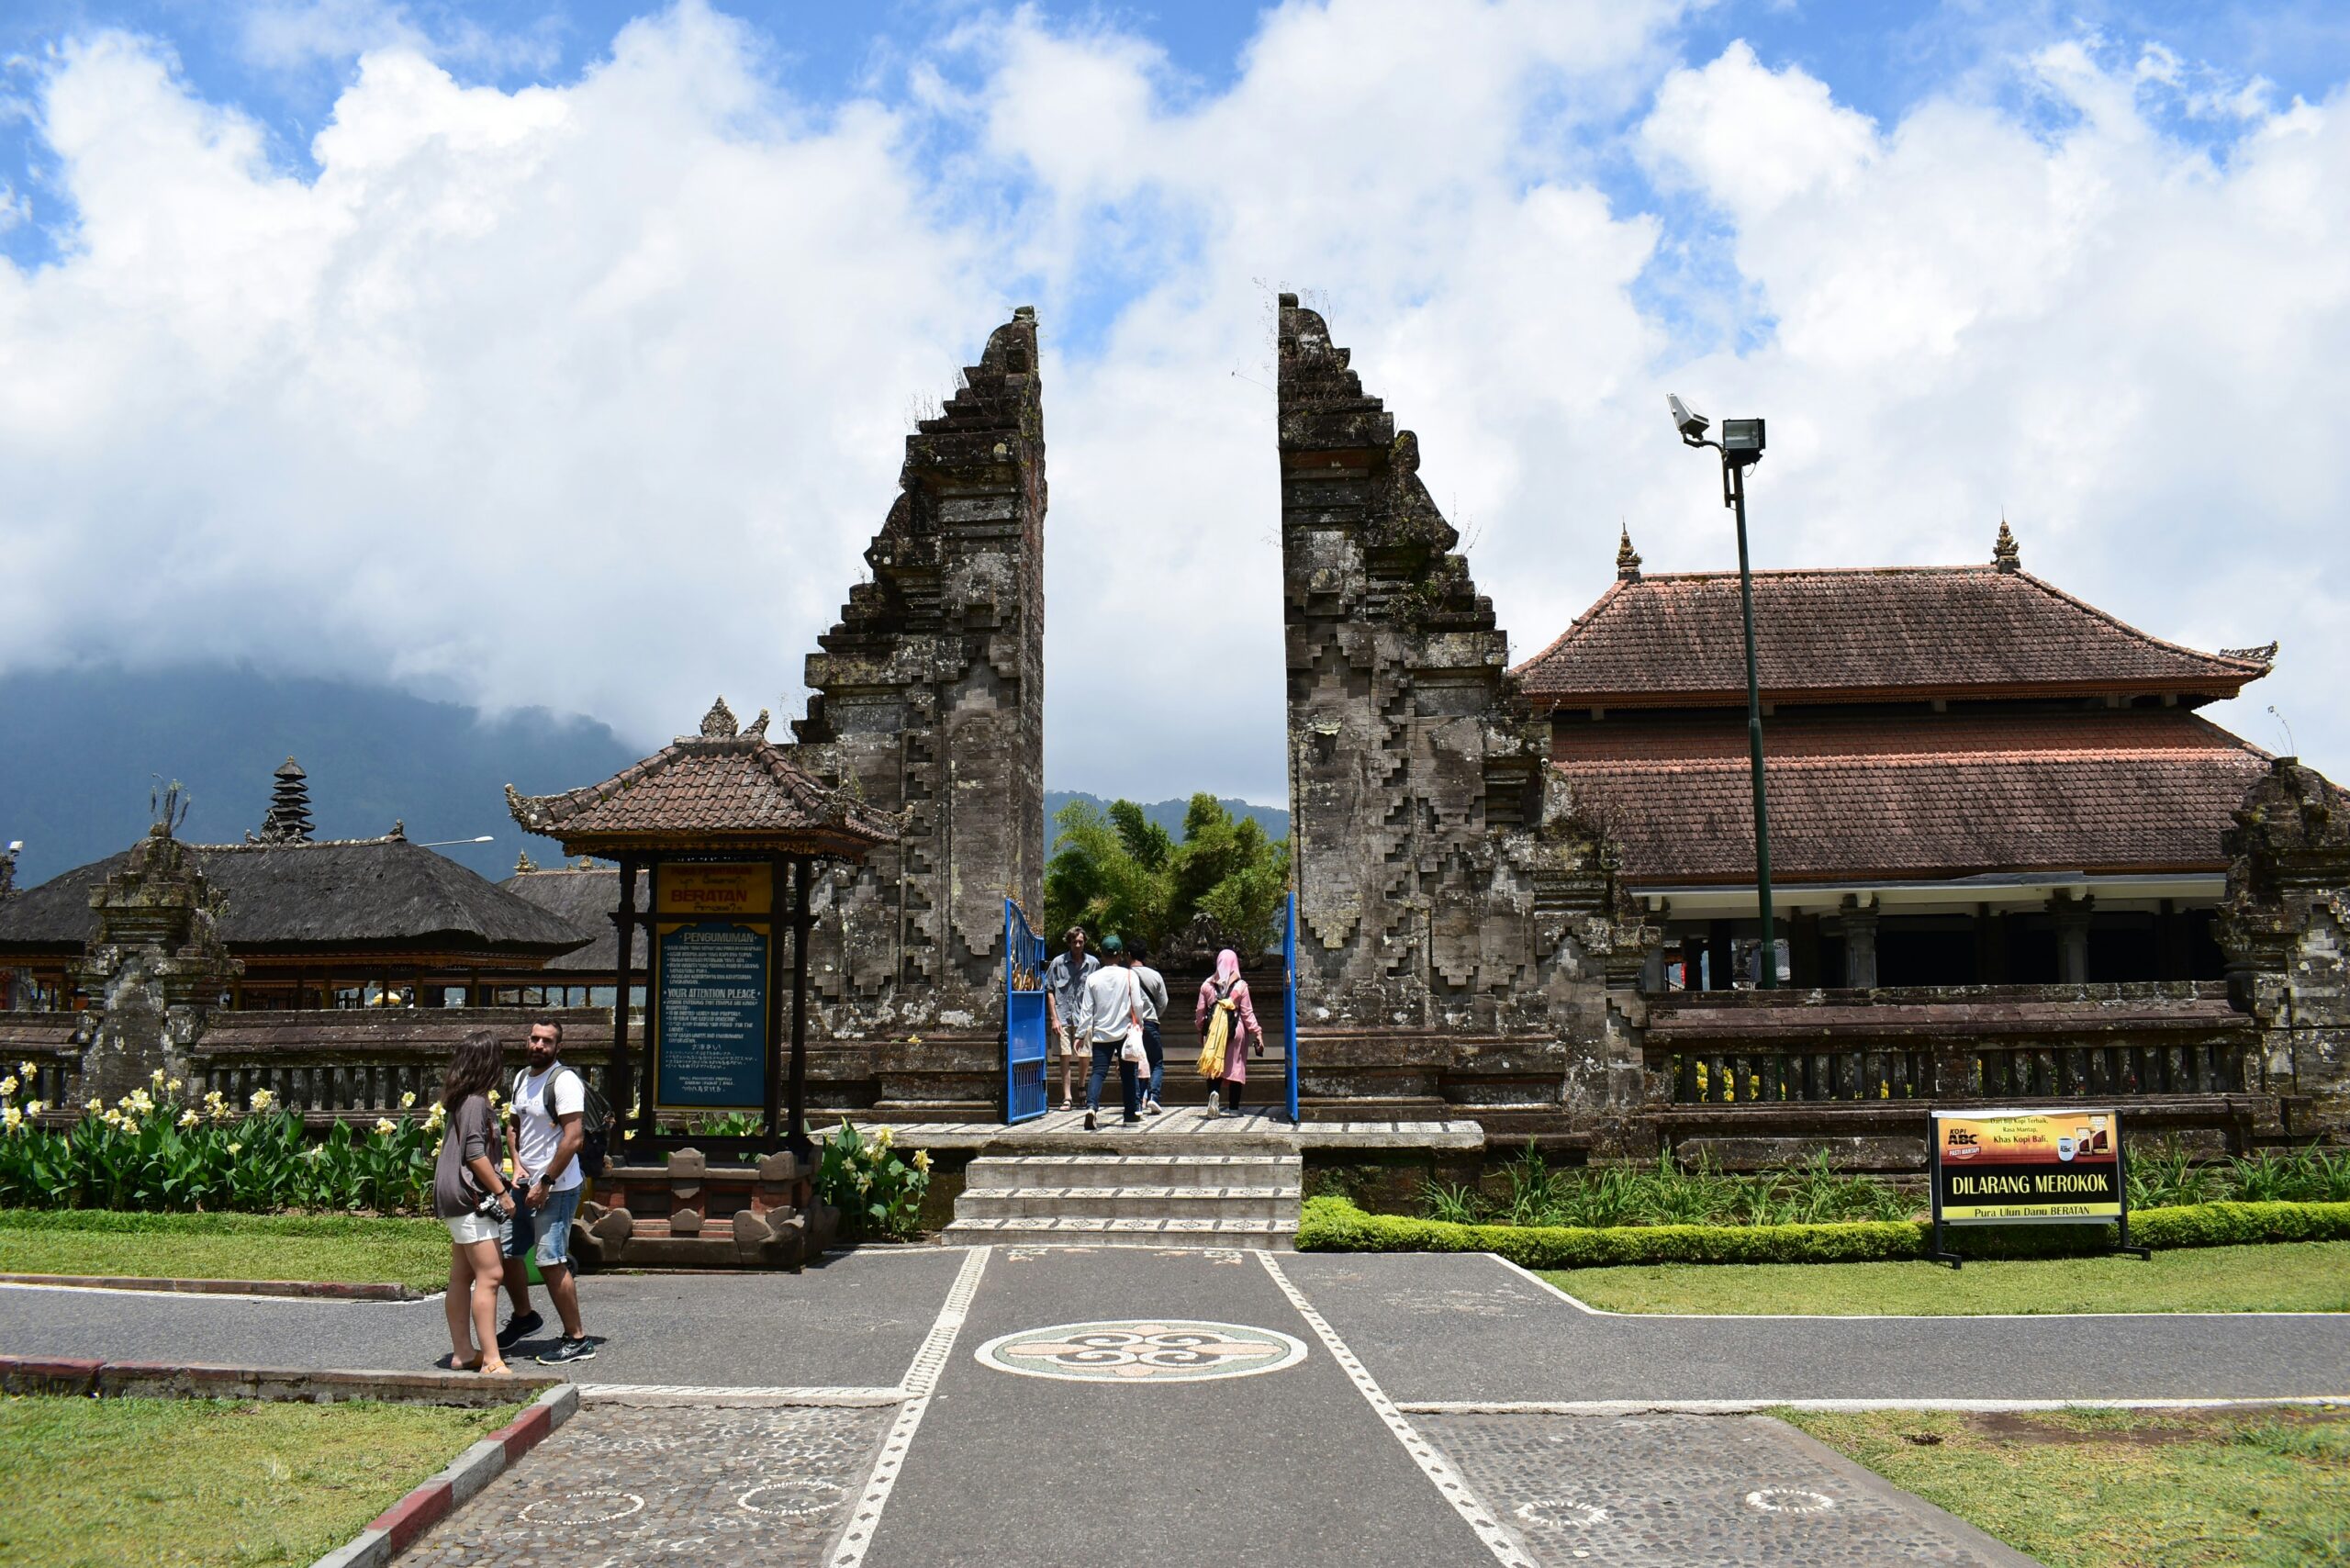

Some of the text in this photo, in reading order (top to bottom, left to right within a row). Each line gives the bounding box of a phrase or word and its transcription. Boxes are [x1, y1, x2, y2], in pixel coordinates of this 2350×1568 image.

[671, 890, 747, 902] BERATAN
[684, 933, 755, 943] PENGUMUMAN
[667, 988, 688, 998] YOUR
[688, 988, 726, 998] ATTENTION
[1948, 1135, 1978, 1146] ABC
[1994, 1135, 2049, 1146] Khas Kopi Bali.
[1953, 1173, 2109, 1195] DILARANG MEROKOK
[1975, 1205, 2090, 1218] Pura Ulun Danu BERATAN
